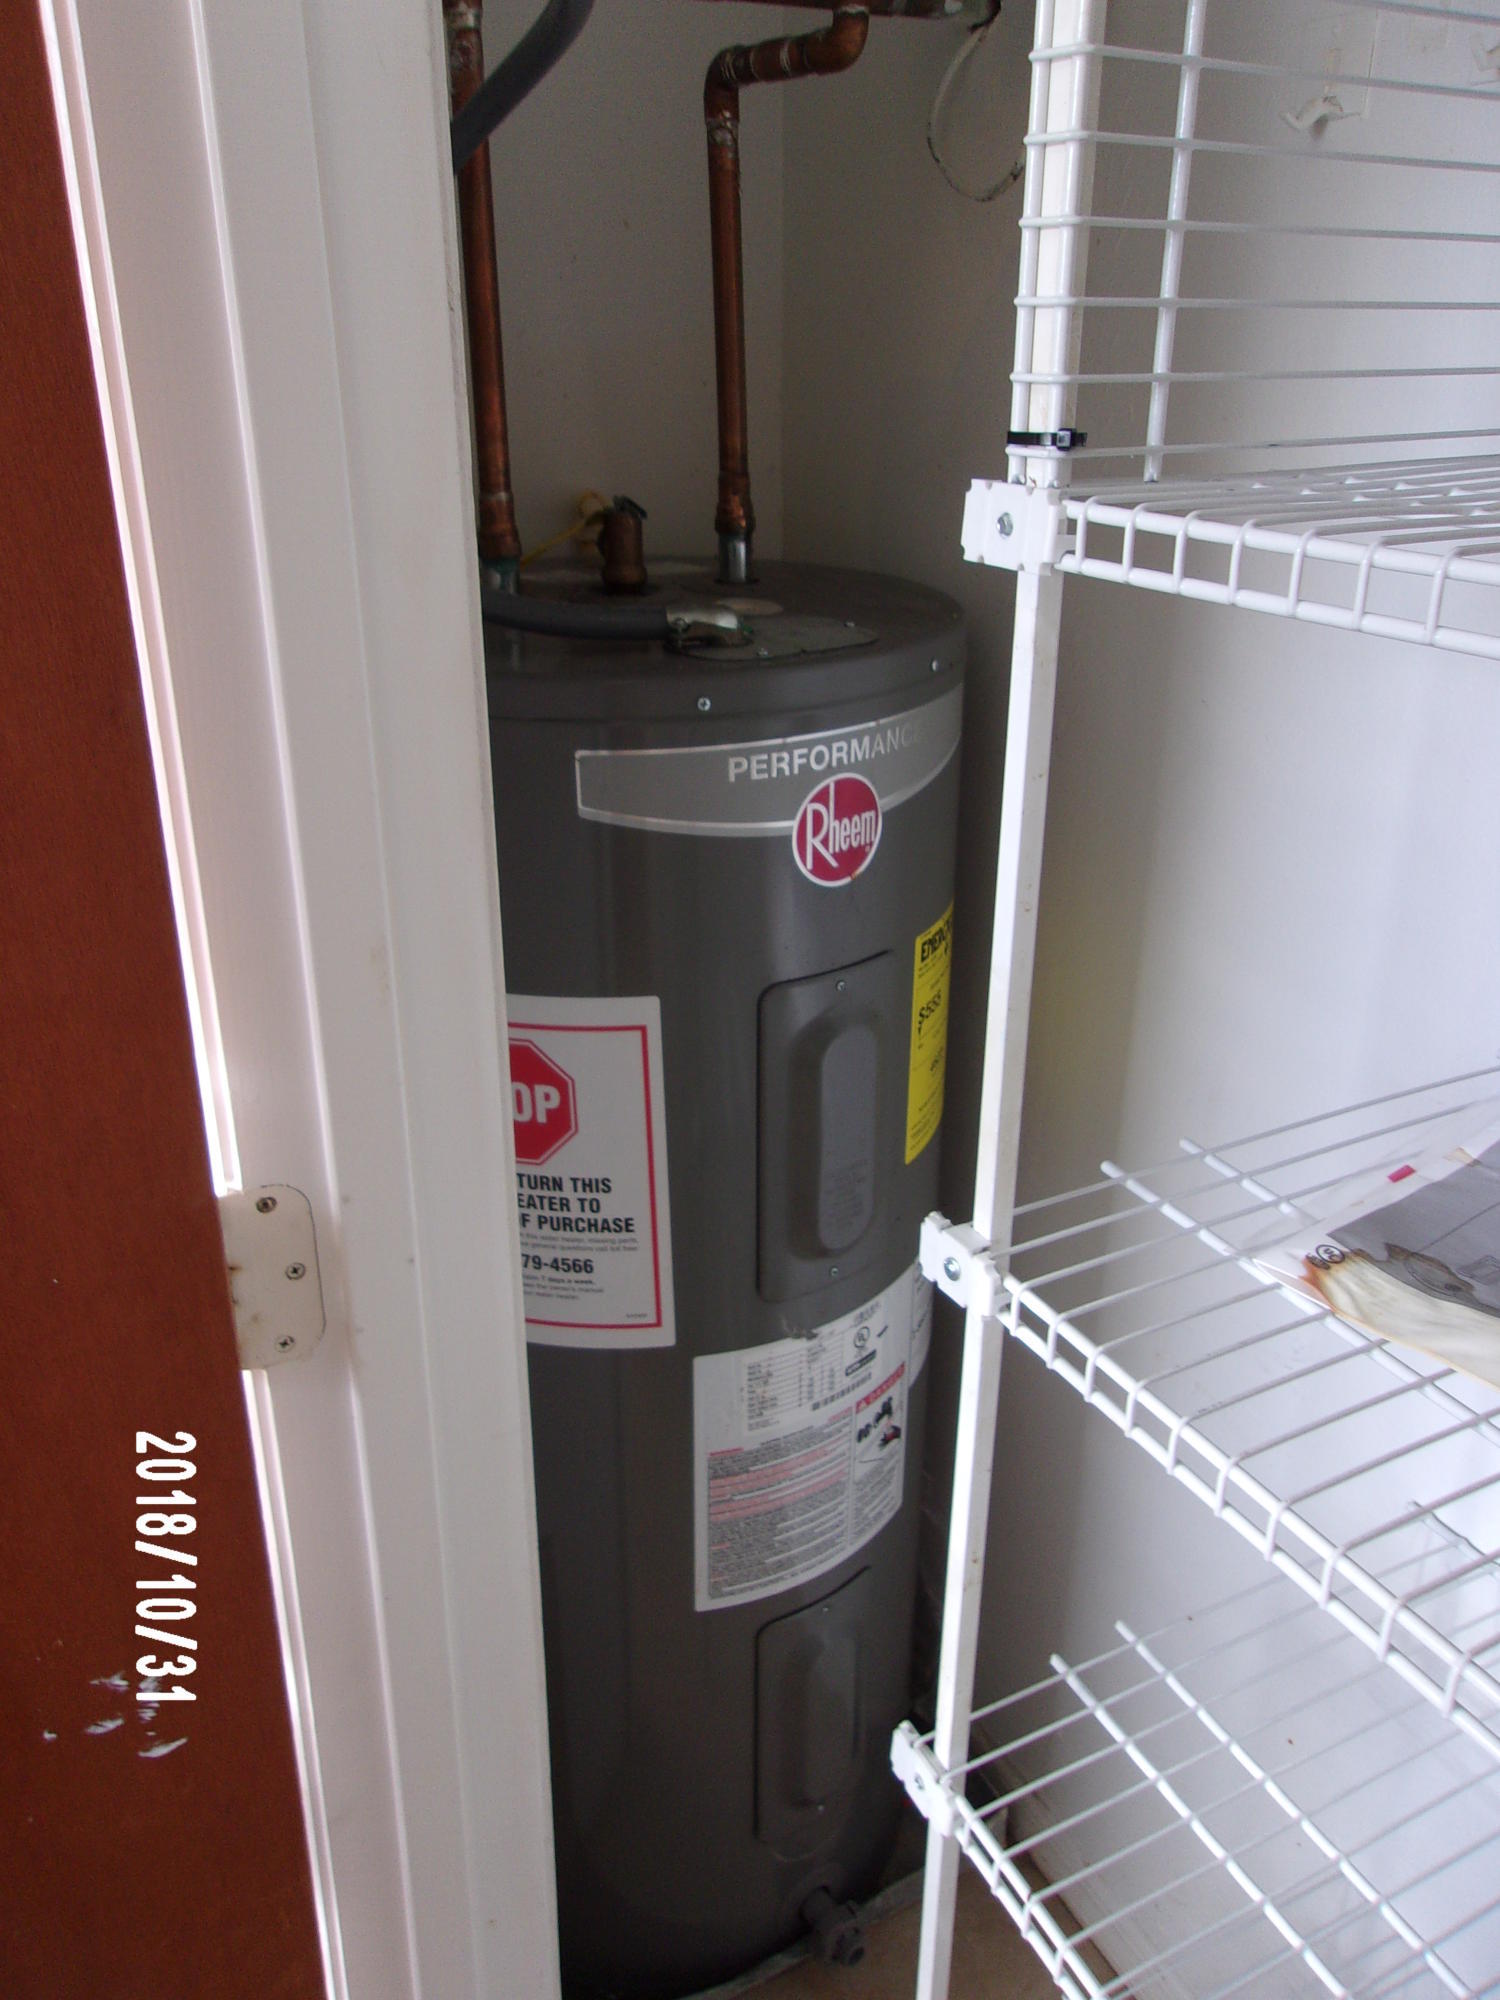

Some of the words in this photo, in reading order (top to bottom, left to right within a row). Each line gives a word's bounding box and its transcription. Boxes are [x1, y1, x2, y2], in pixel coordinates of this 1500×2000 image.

[728, 722, 922, 783] PERFORMANC
[806, 781, 877, 871] Rheem
[569, 1177, 612, 1194] THIS
[577, 1197, 601, 1213] TO
[518, 1213, 531, 1228] F
[537, 1215, 635, 1234] PURCHASE
[521, 1253, 594, 1274] 79-4566
